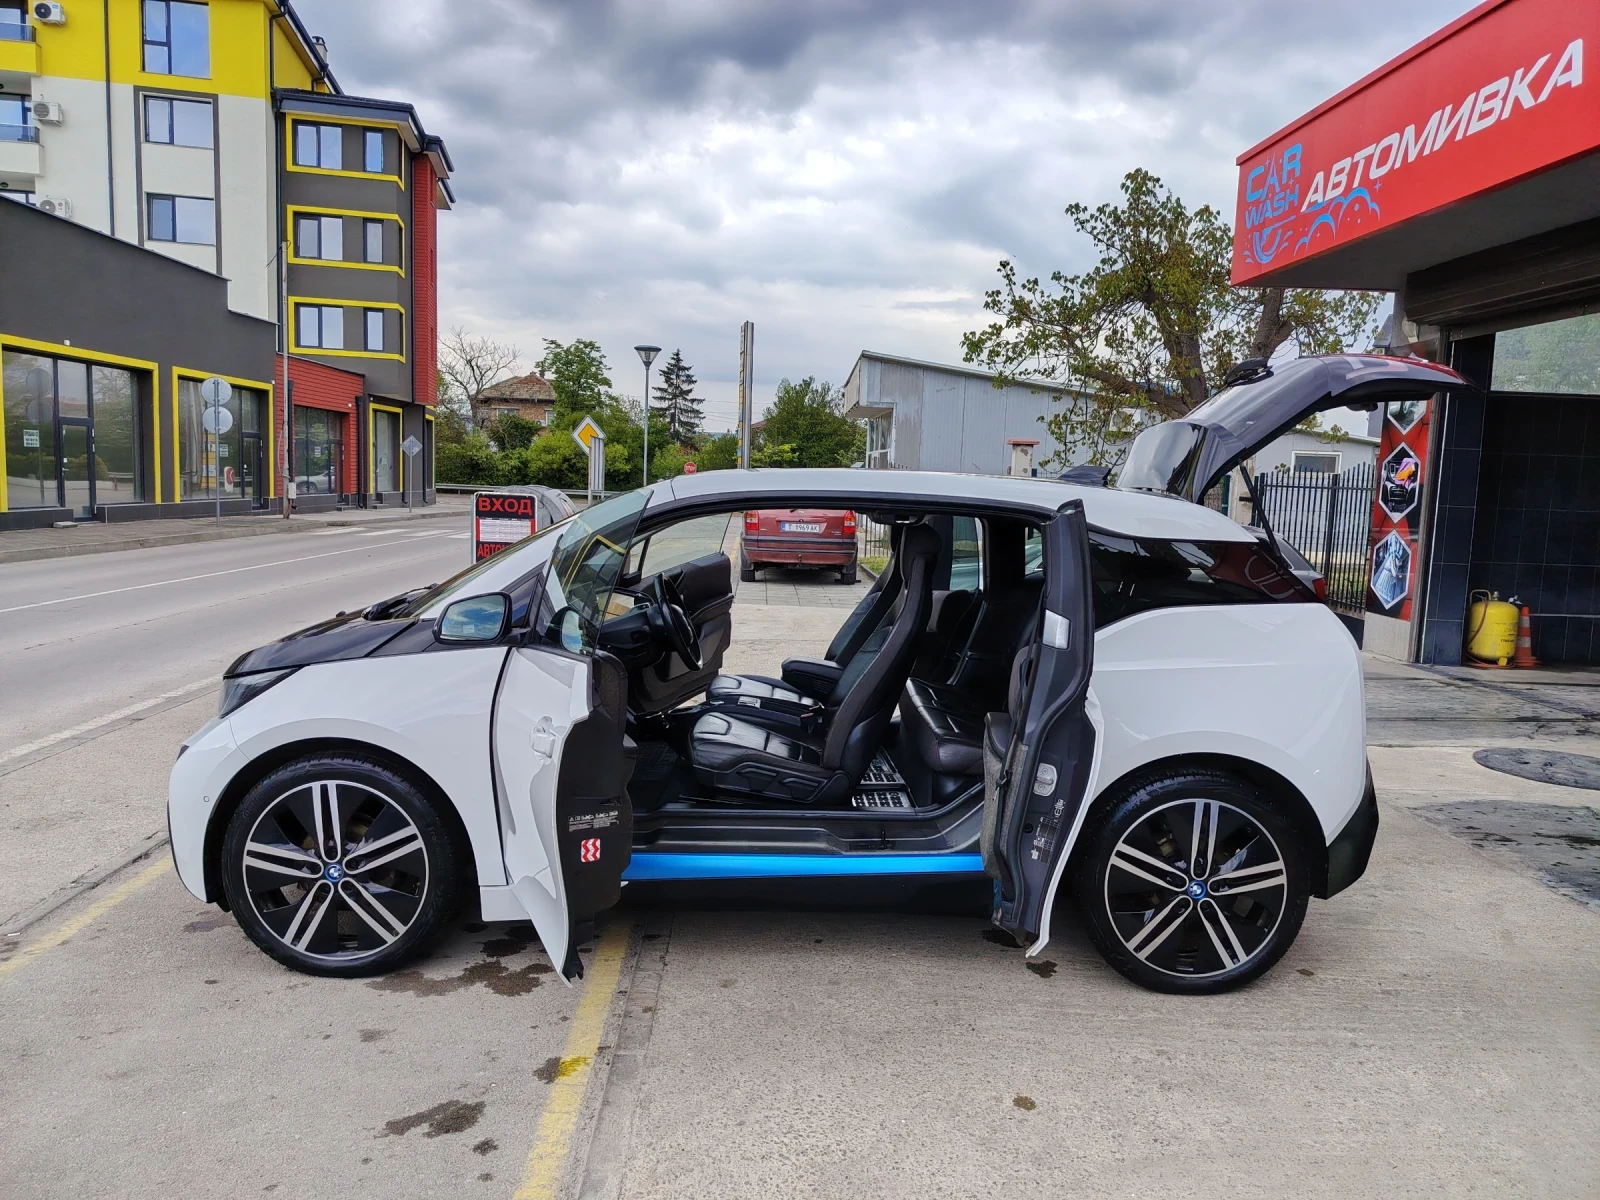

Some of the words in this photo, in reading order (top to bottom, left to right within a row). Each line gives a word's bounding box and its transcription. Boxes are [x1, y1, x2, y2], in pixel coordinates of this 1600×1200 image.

[1300, 38, 1583, 213] АВТОМИВКА
[1246, 143, 1302, 202] CAR
[1245, 184, 1299, 229] WASH
[478, 497, 532, 515] ВХОД
